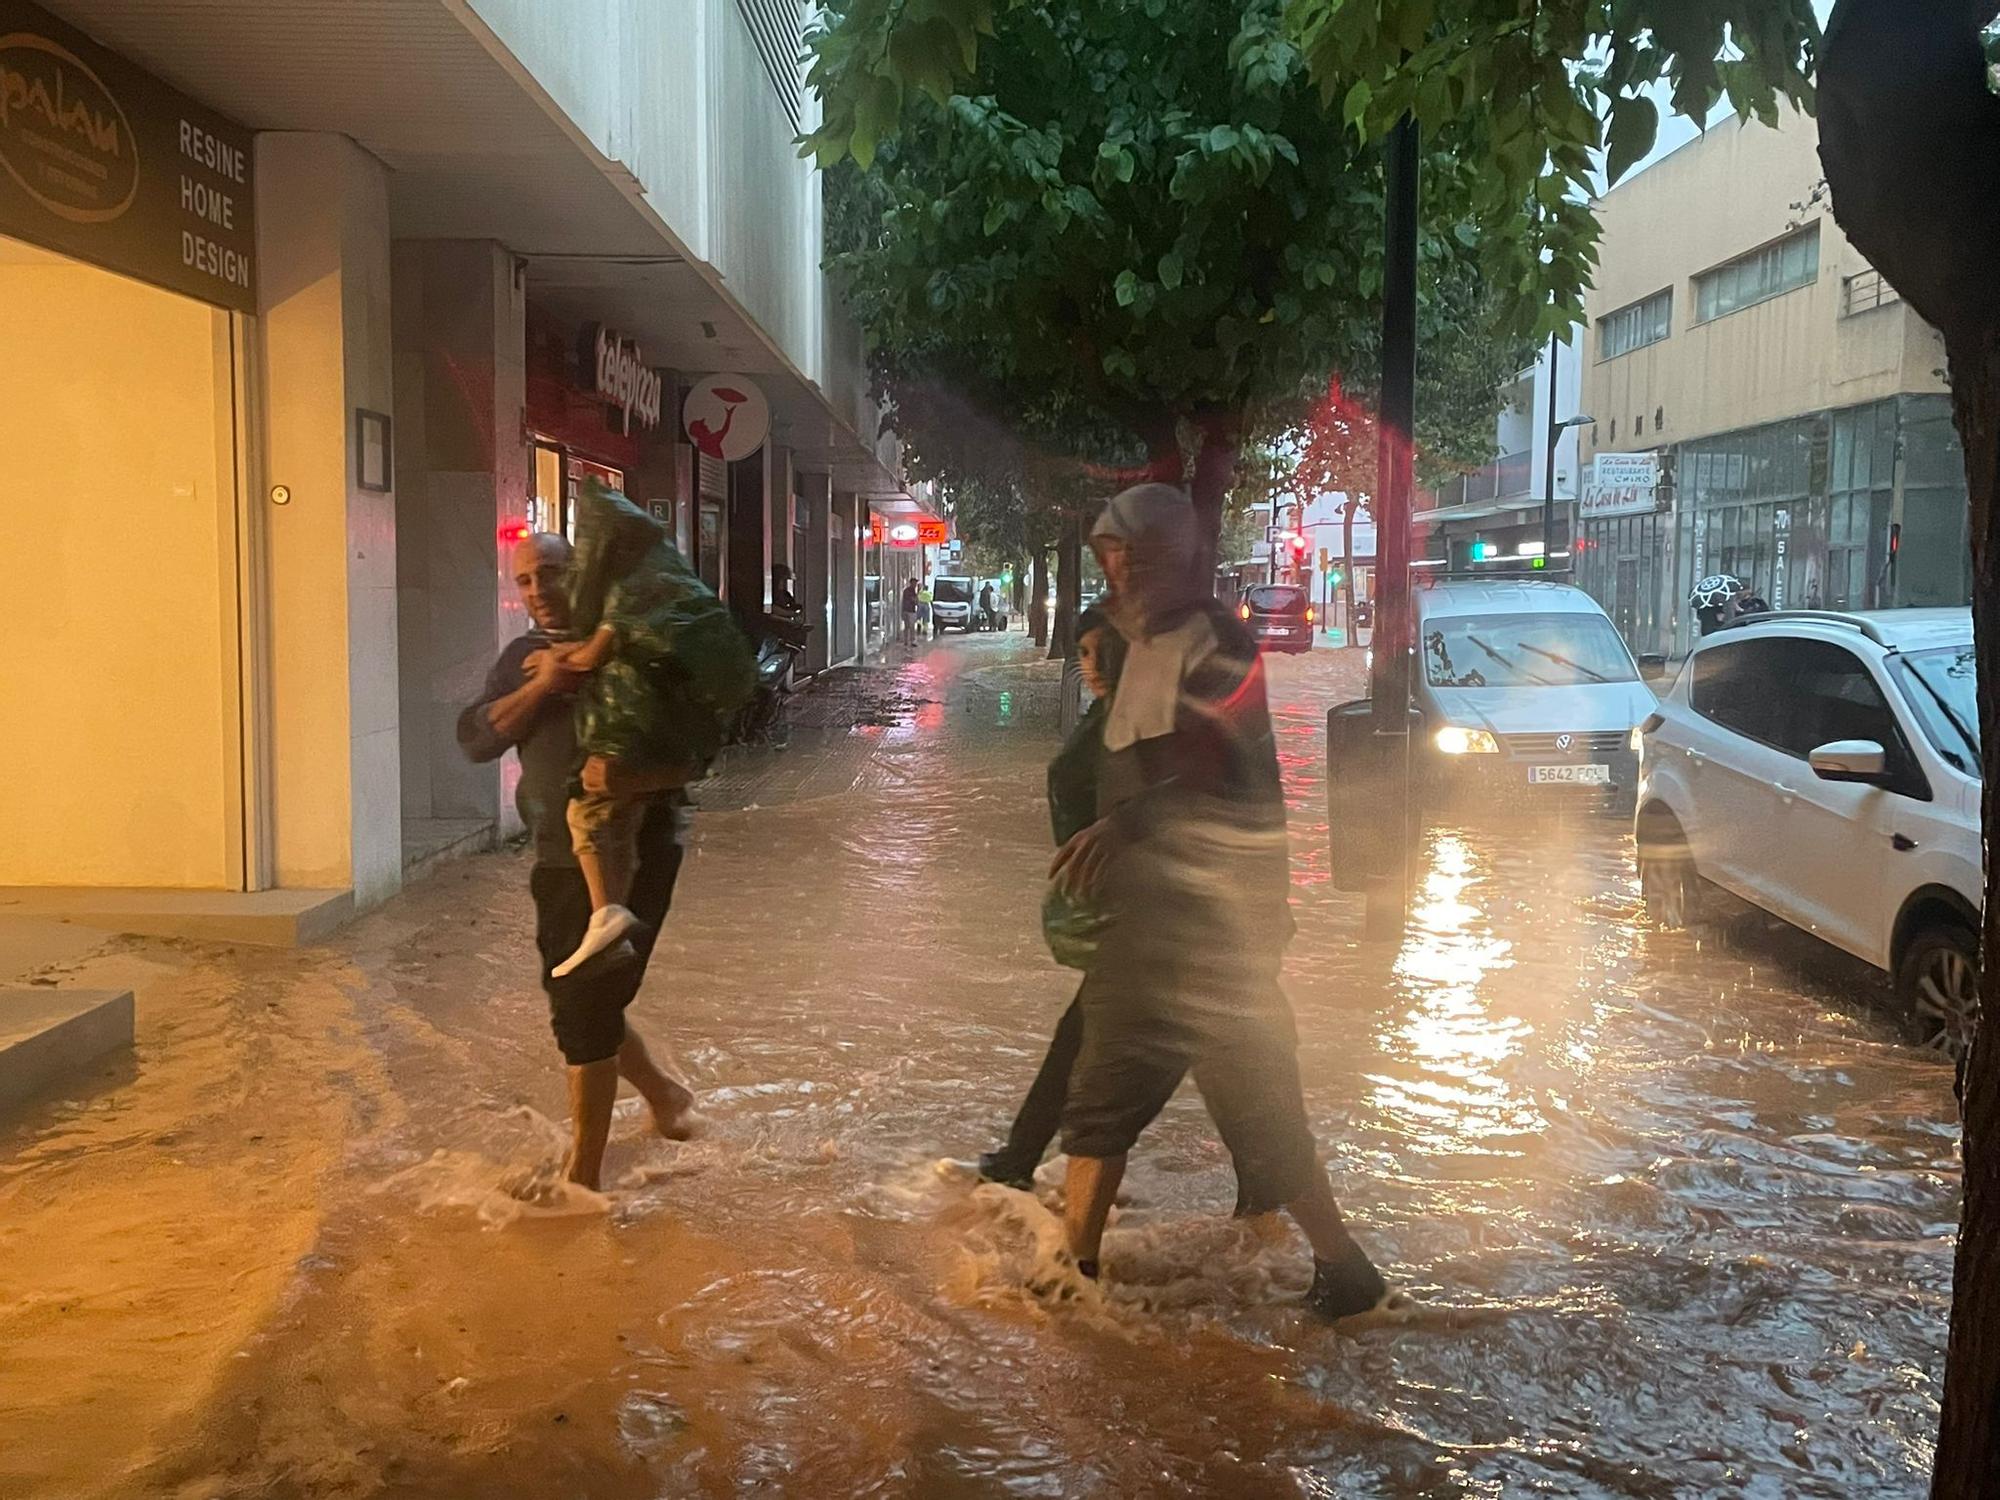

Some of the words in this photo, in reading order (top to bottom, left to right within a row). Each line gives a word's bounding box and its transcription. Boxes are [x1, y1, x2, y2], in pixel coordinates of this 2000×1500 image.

[179, 119, 245, 183] RESINE
[181, 175, 233, 230] HOME
[182, 230, 249, 288] DESIGN
[597, 327, 662, 437] telepizza
[654, 505, 664, 517] R
[1538, 767, 1573, 781] 5642
